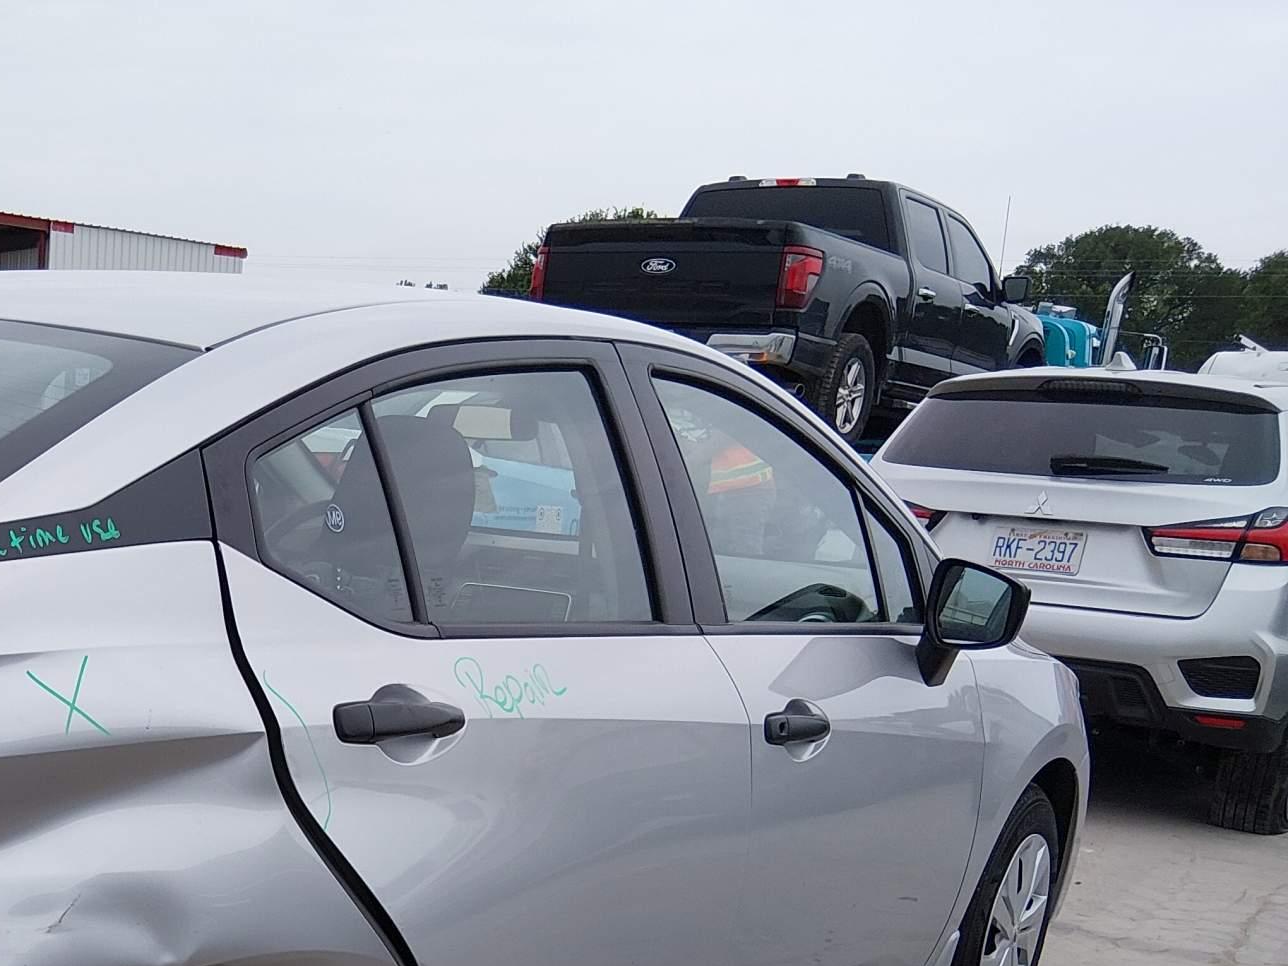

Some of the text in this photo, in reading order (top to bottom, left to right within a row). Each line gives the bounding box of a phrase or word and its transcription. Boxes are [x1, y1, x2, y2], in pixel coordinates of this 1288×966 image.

[993, 537, 1078, 562] RKF-2397
[994, 559, 1072, 573] NORTH CAROLINA
